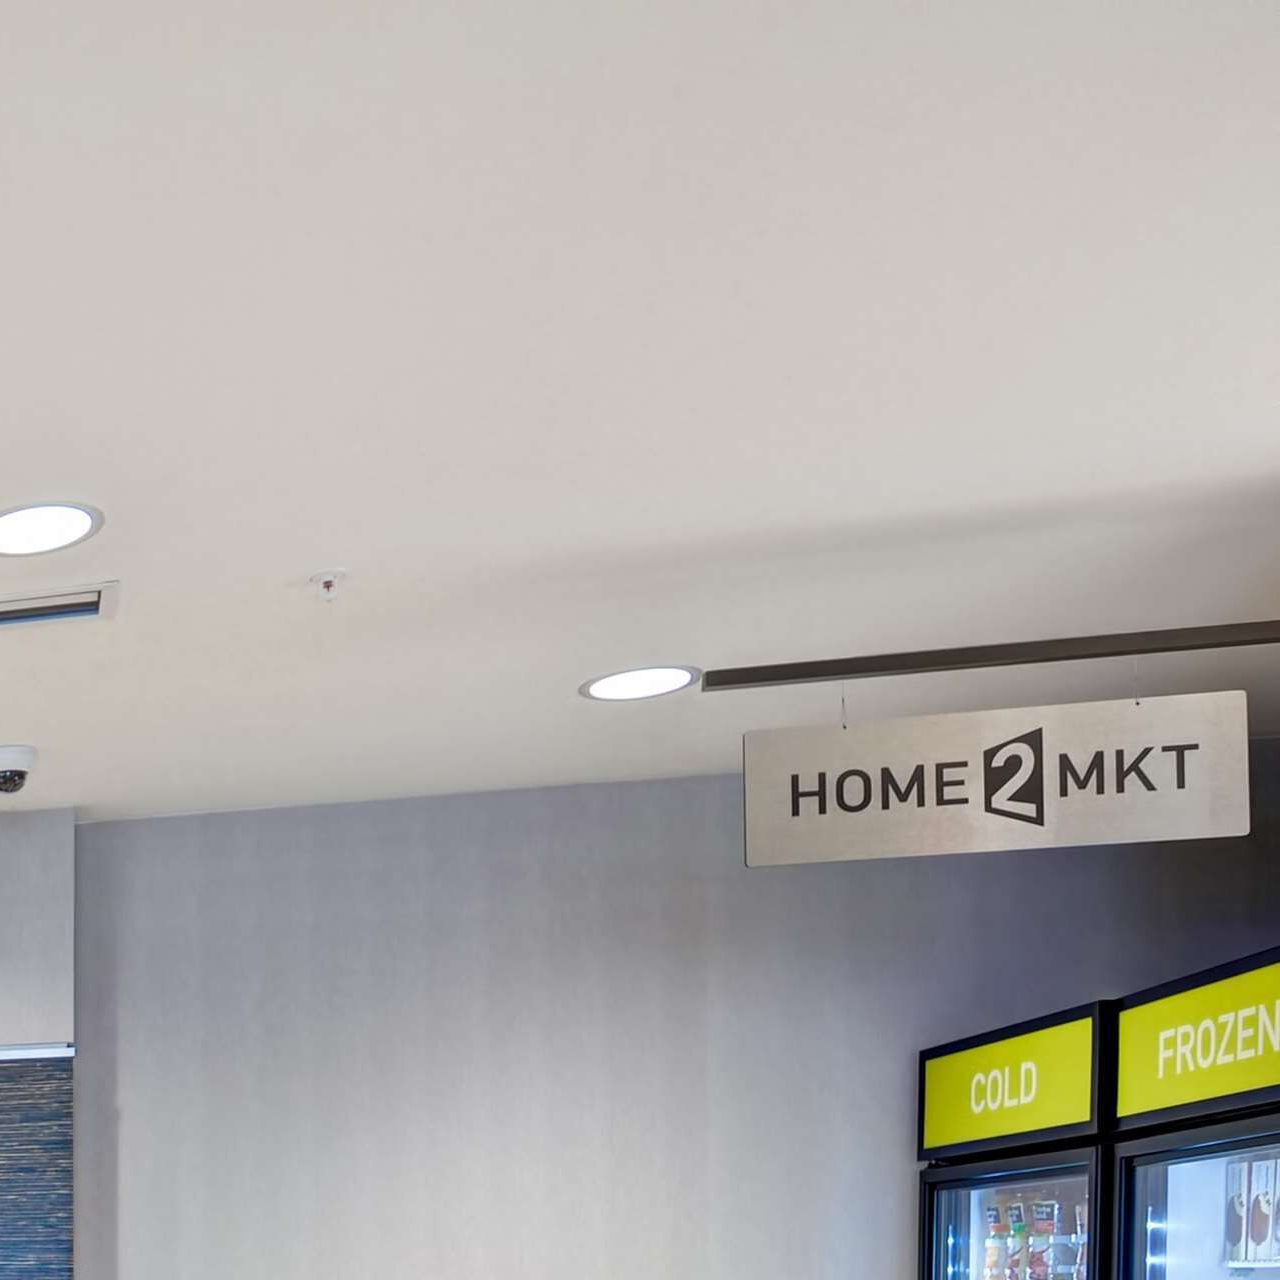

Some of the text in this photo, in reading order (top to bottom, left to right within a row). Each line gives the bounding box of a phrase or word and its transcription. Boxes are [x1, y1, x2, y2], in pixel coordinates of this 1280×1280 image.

[790, 760, 969, 817] HOME
[1058, 743, 1200, 799] MKT
[1157, 999, 1280, 1079] FROZEN
[970, 1061, 1038, 1114] COLD
